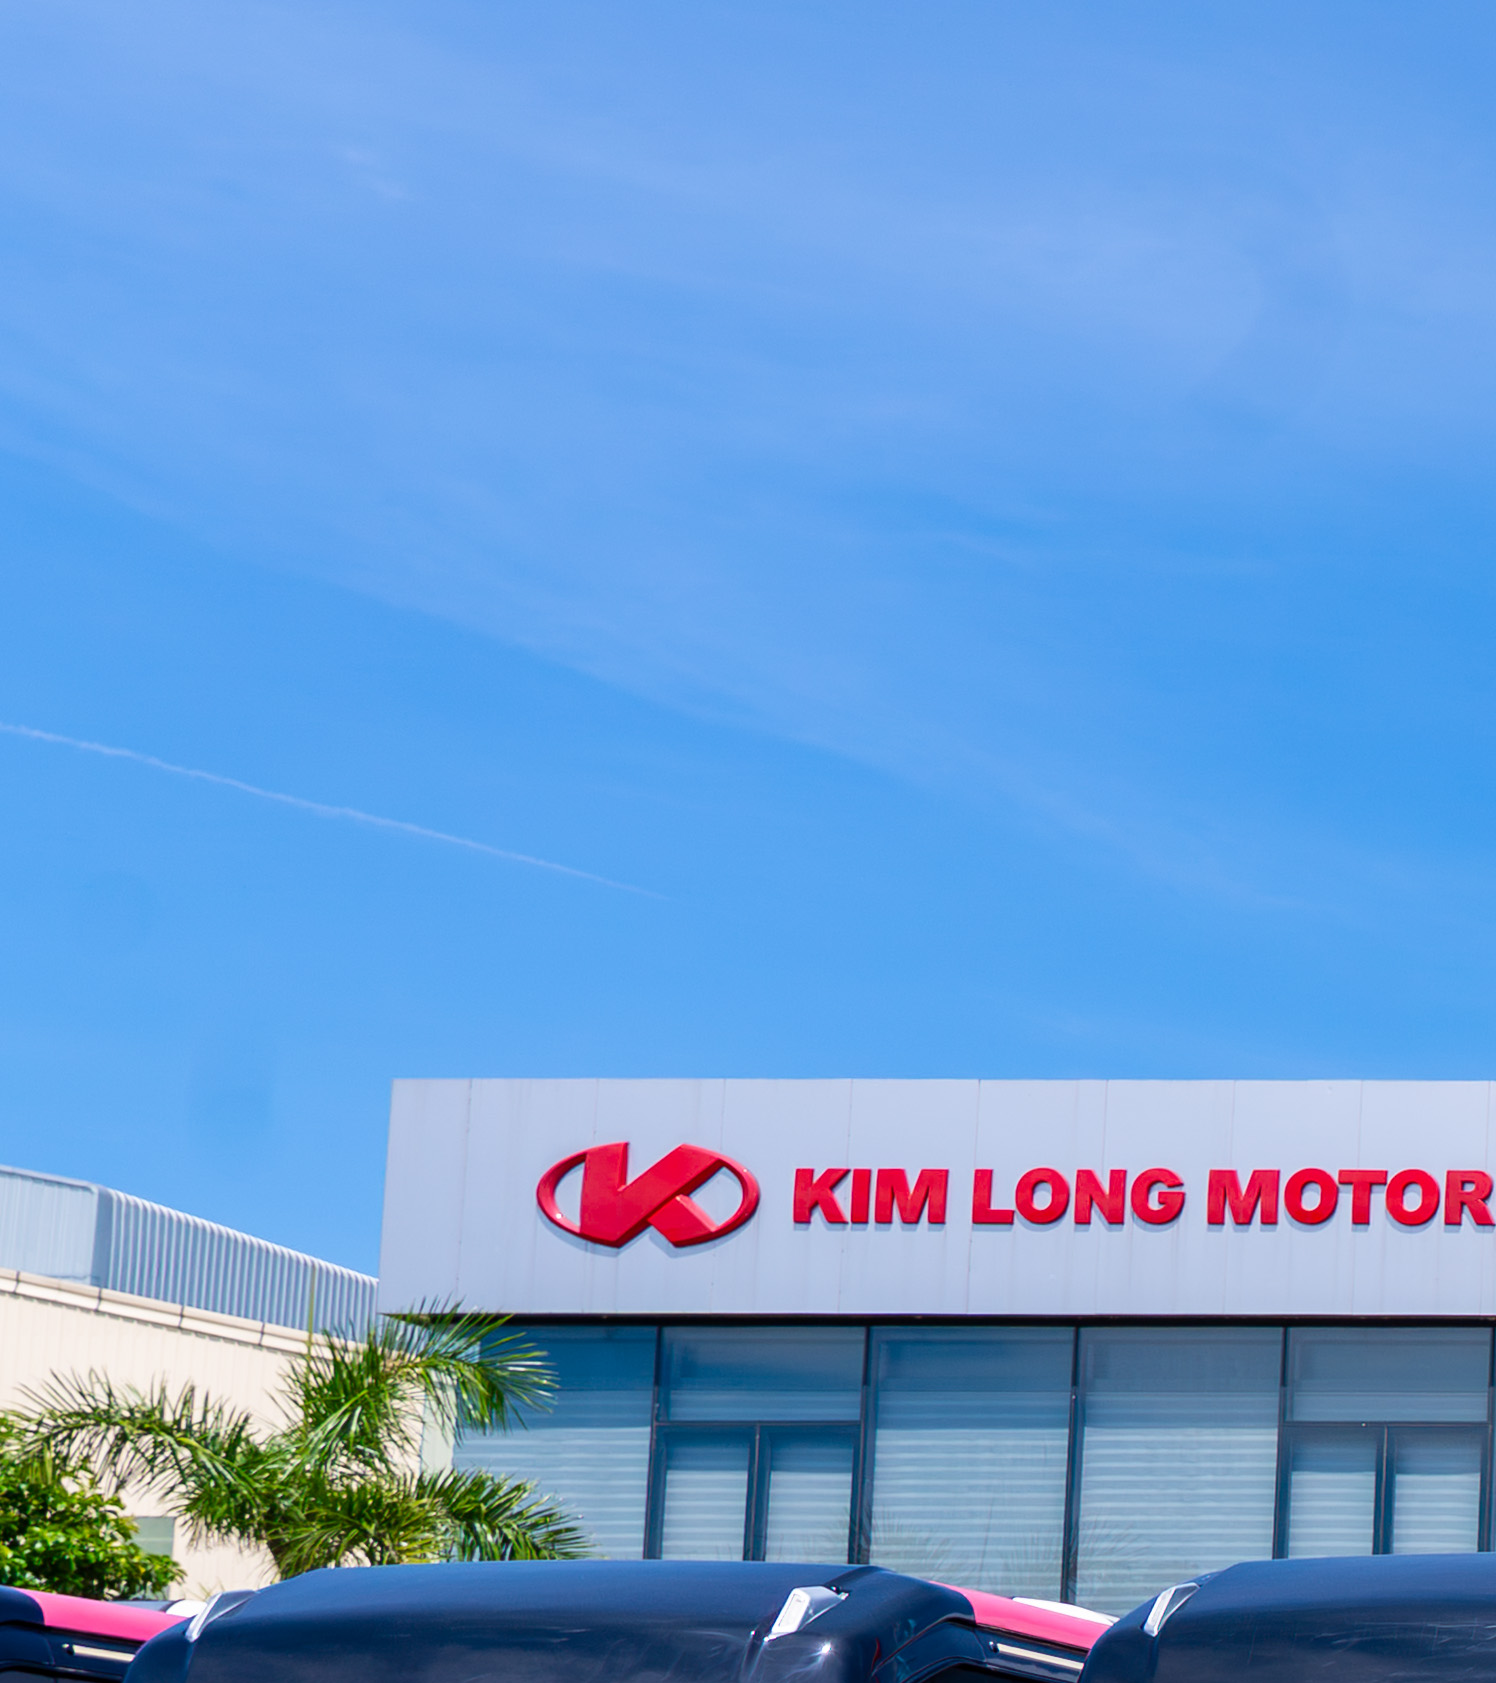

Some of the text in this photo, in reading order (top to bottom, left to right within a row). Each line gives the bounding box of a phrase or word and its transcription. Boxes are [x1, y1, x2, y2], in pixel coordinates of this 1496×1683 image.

[792, 1167, 1495, 1226] KIM LONG MOTOR
